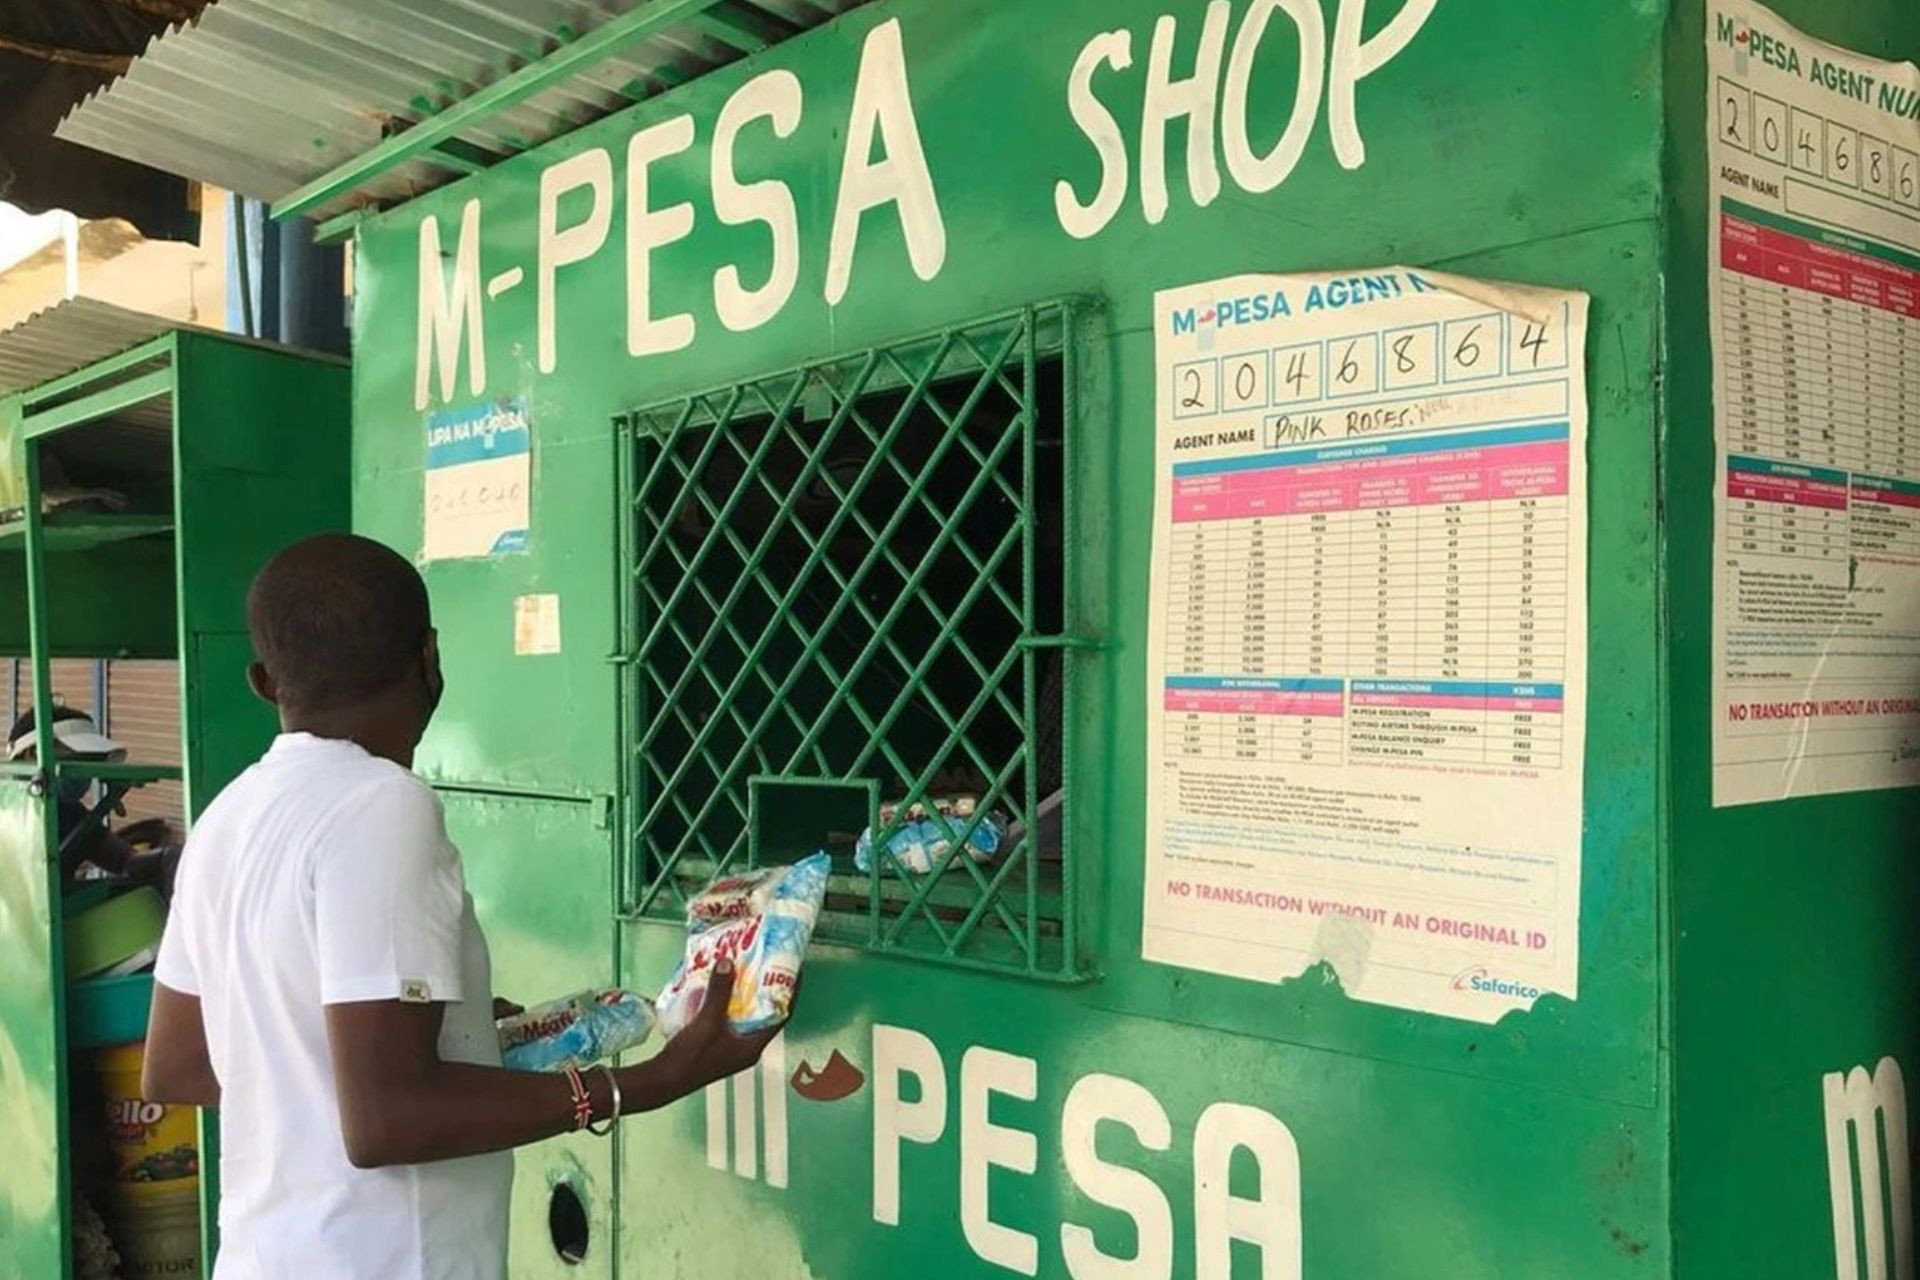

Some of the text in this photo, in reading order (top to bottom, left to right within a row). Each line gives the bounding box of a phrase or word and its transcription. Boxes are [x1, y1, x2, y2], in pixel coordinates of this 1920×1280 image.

[1810, 58, 1875, 104] AGENT
[415, 0, 1441, 411] M-PESA SHOP
[1304, 273, 1402, 313] AGENT
[1174, 428, 1256, 450] AGENT NAME
[1274, 415, 1327, 448] PINK
[1729, 703, 1748, 721] NO
[1750, 700, 1820, 720] TRANSACTION
[1167, 881, 1191, 897] NO
[1195, 883, 1303, 914] TRANSACTION
[1391, 912, 1420, 931] AN
[1425, 915, 1520, 947] ORIGINAL
[1525, 931, 1548, 950] ID
